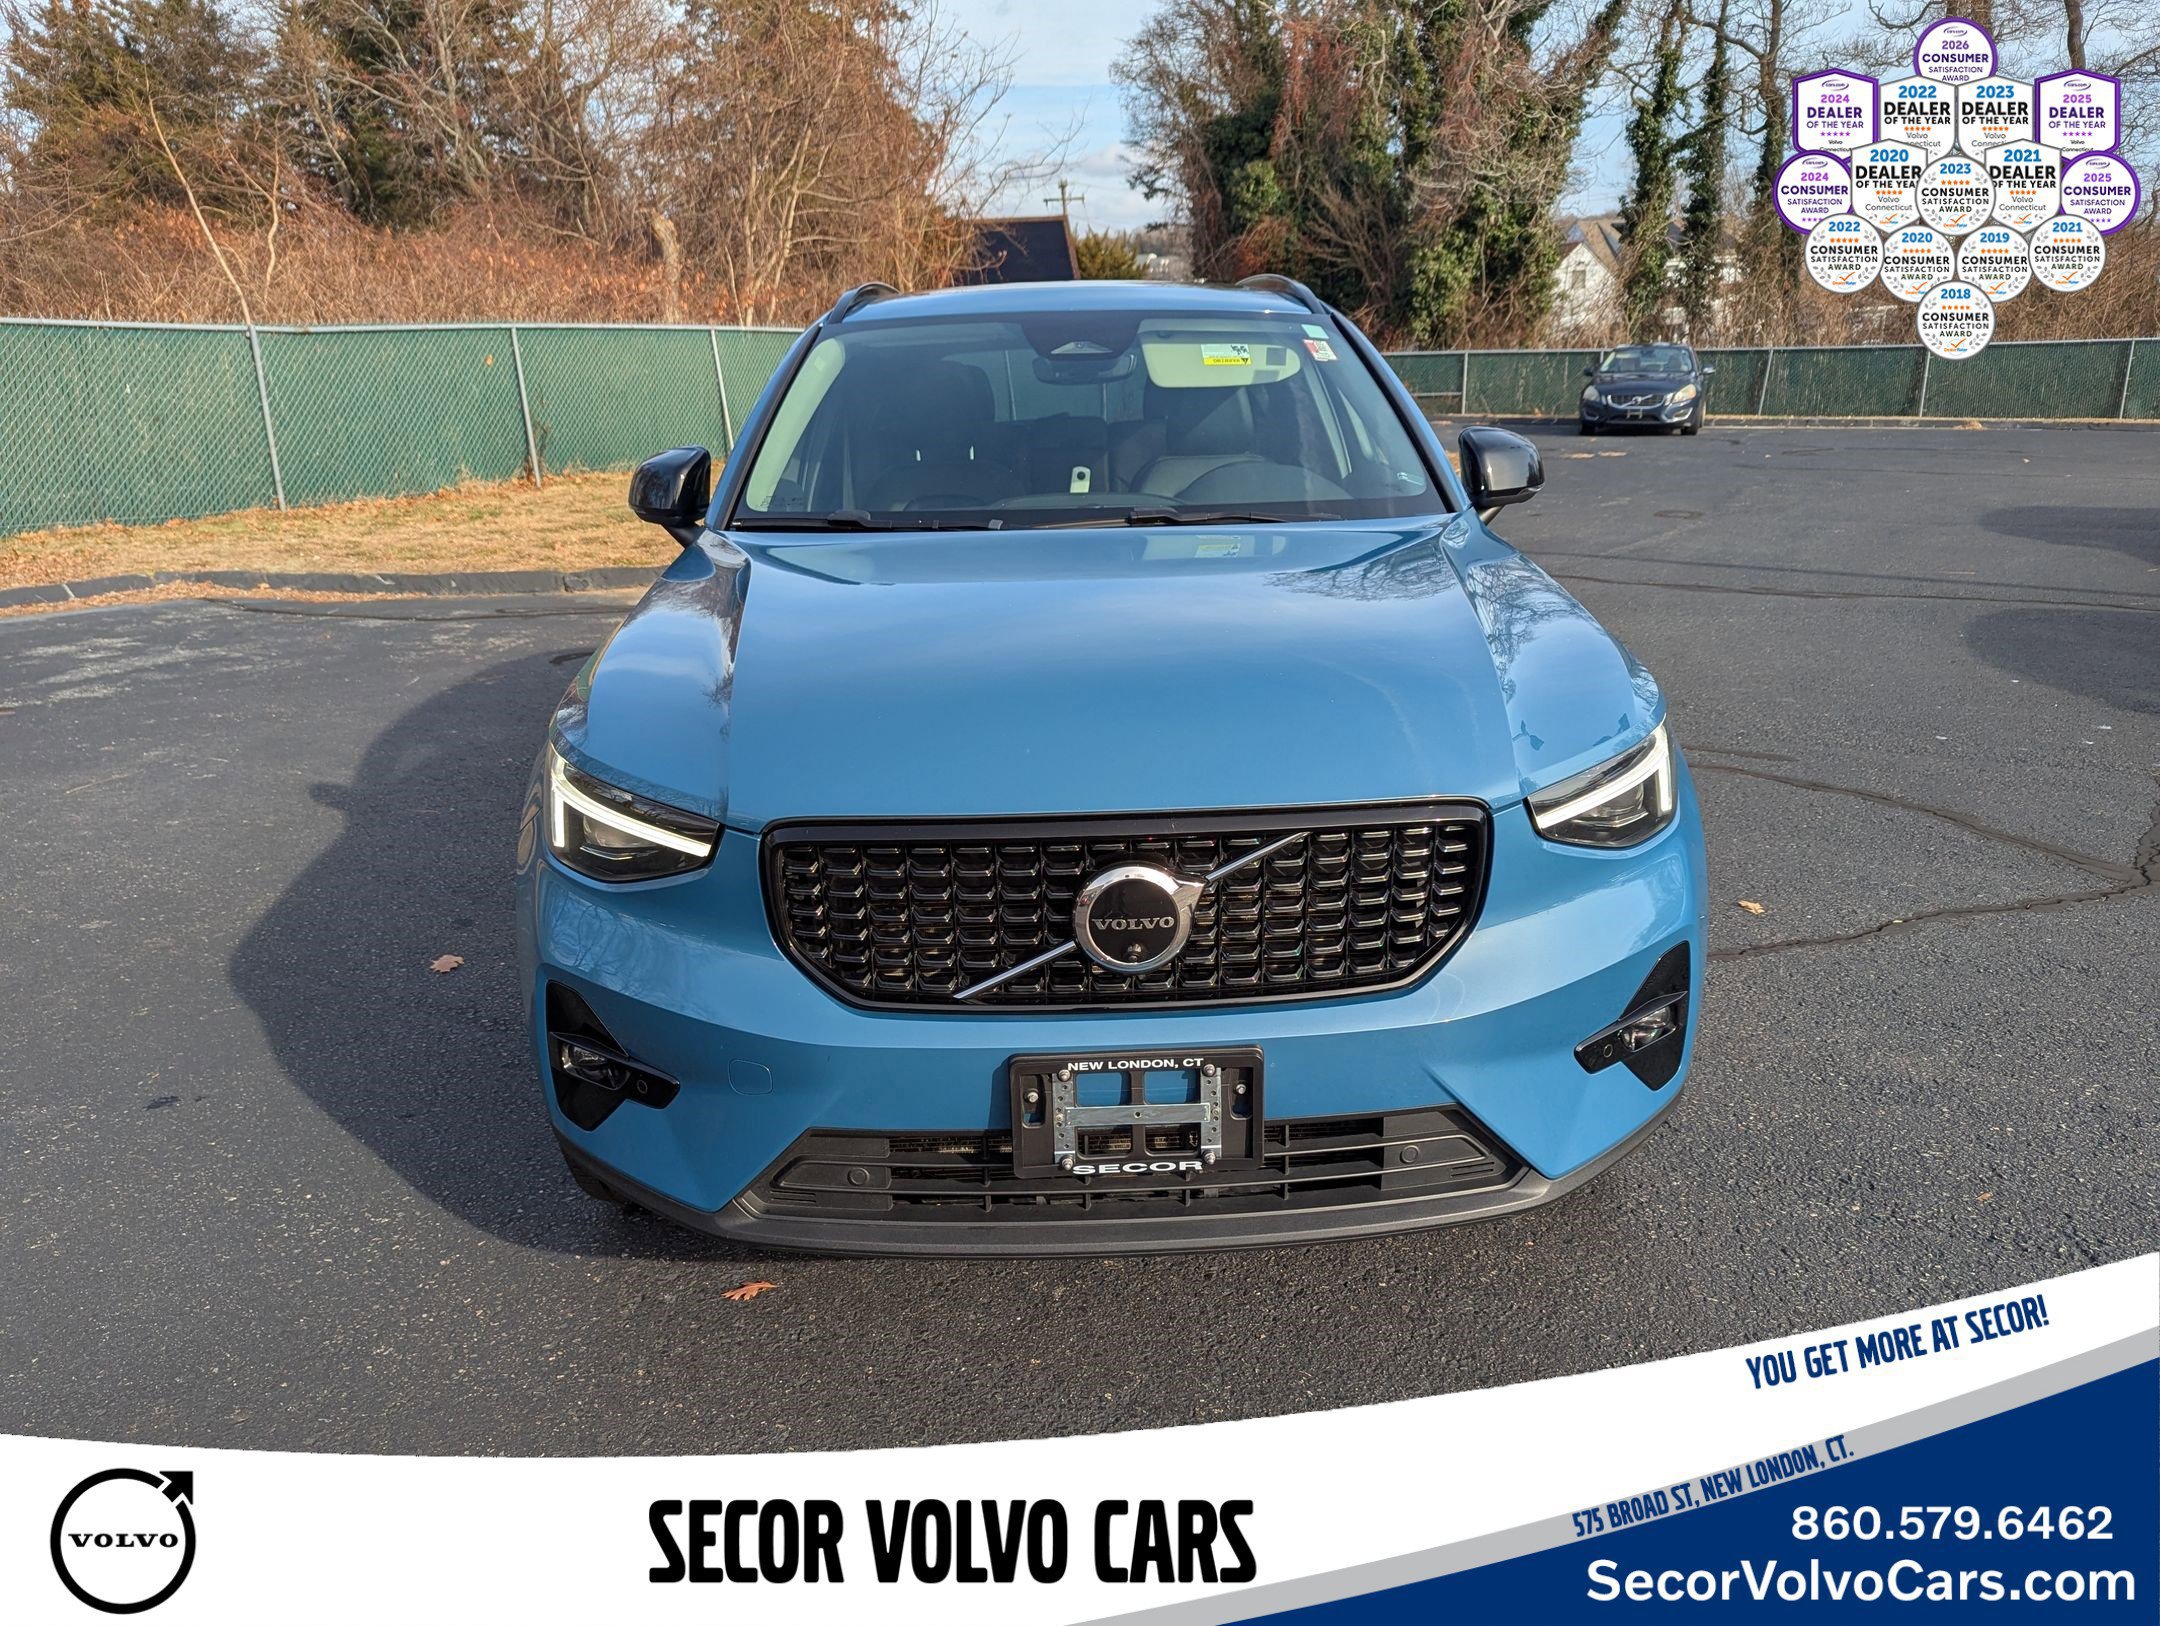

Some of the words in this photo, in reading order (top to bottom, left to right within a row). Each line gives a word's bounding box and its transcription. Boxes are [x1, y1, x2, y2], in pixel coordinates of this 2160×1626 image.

[1092, 917, 1175, 930] VOLVO
[1068, 1061, 1103, 1071] NEW
[1108, 1059, 1179, 1070] LONDON,
[1183, 1058, 1204, 1067] CT
[1073, 1161, 1202, 1175] SECOR
